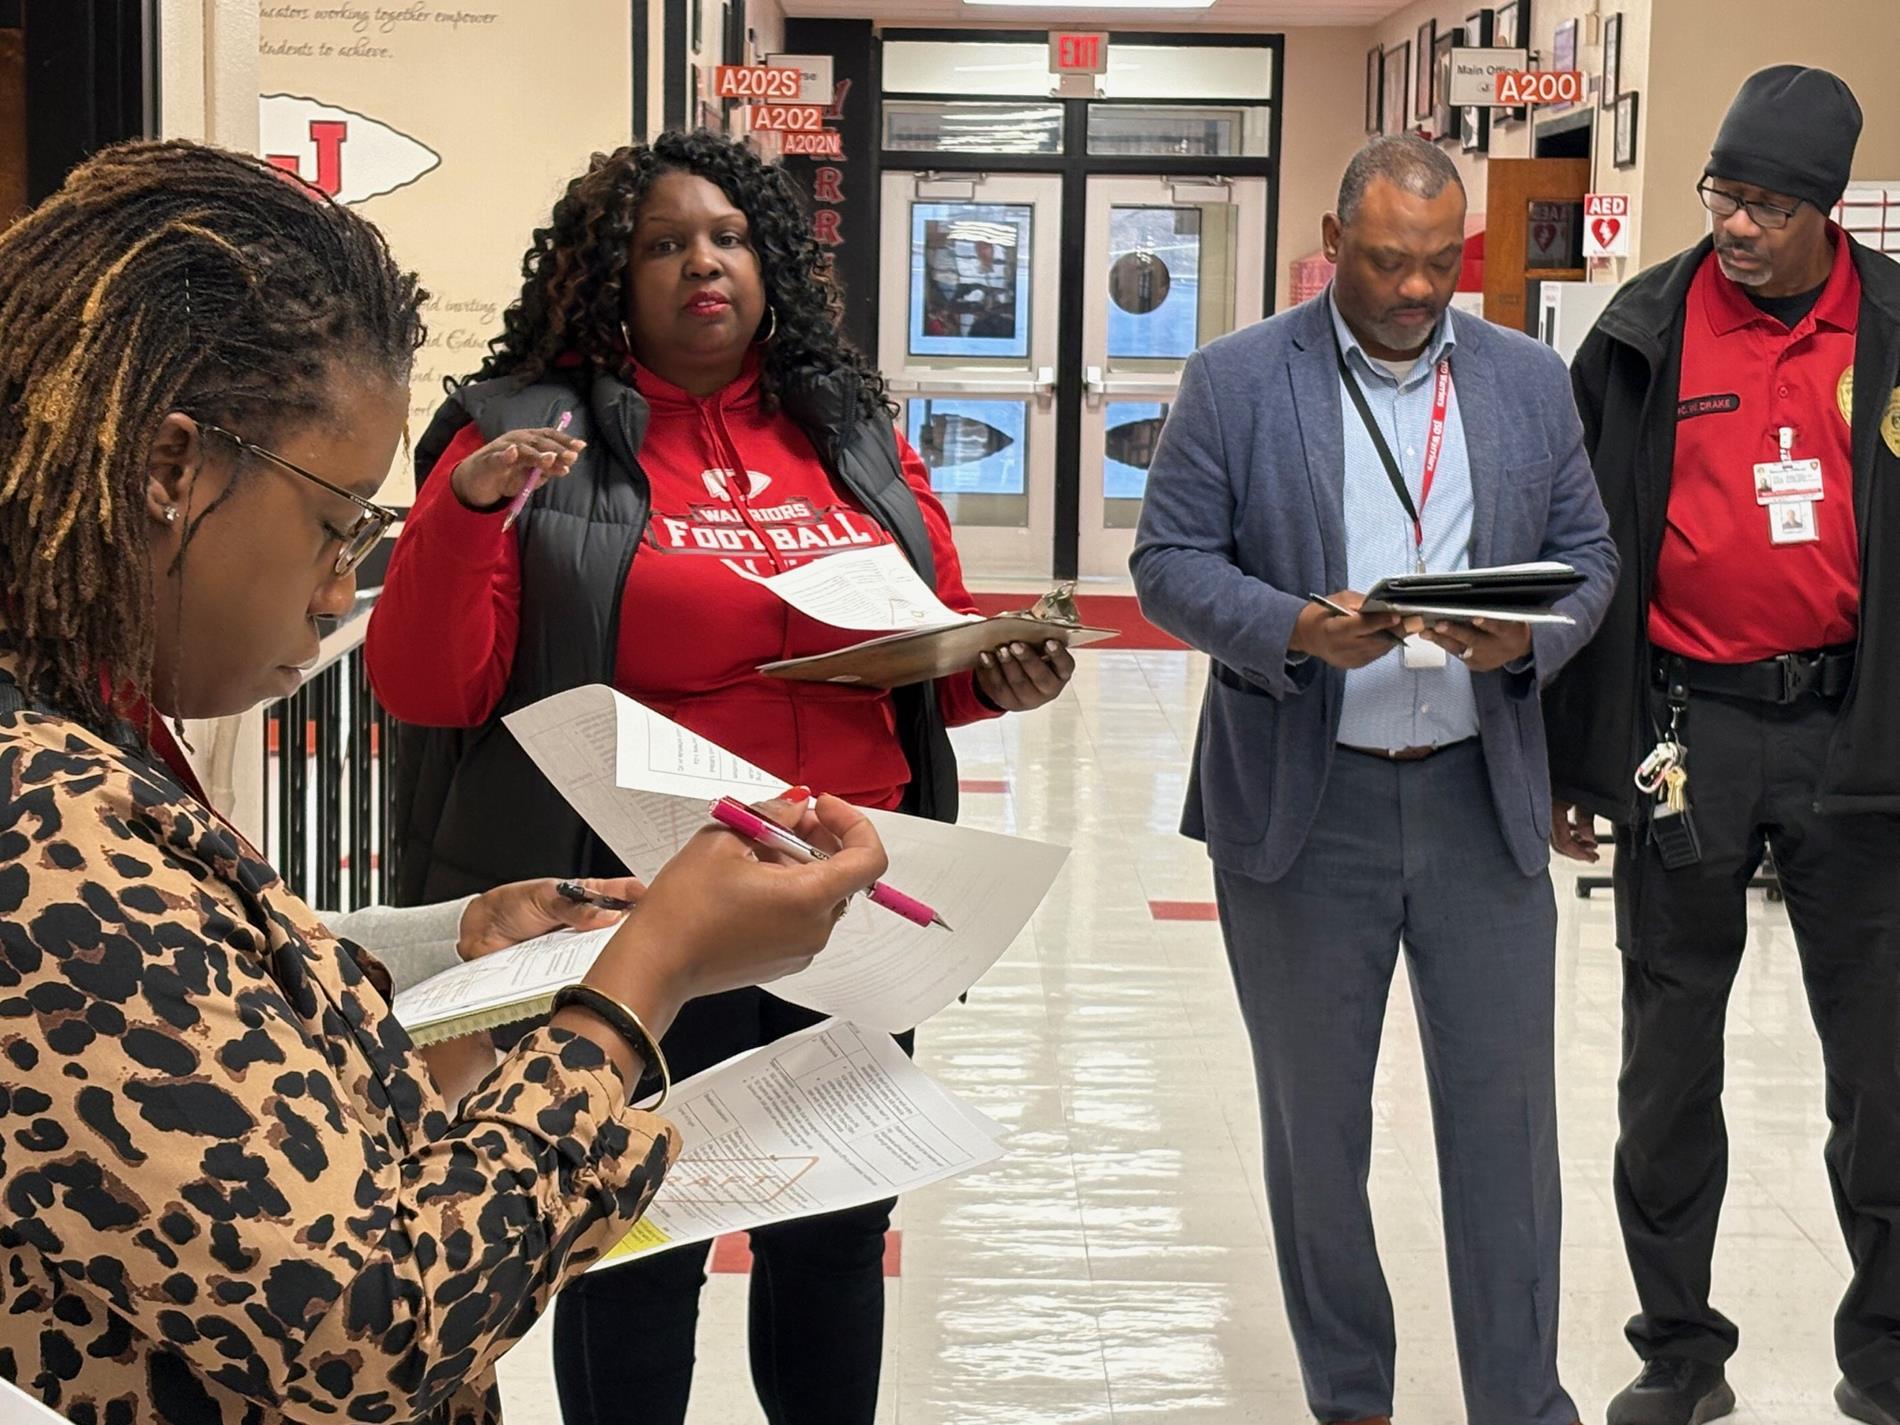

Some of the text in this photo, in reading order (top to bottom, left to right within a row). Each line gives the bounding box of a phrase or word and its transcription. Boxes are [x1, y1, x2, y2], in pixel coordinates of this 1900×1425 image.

[314, 0, 370, 33] working
[374, 0, 432, 34] together
[434, 10, 499, 31] empower
[318, 42, 334, 56] to
[337, 36, 394, 58] achieve.
[1059, 35, 1100, 68] EXIT
[721, 68, 798, 97] A202S
[1456, 65, 1484, 76] Main
[1500, 73, 1577, 102] A200
[754, 107, 819, 130] A202
[785, 134, 840, 153] A202N
[1589, 196, 1626, 215] AED
[1437, 373, 1448, 407] Warriors
[1426, 435, 1440, 471] Warriors
